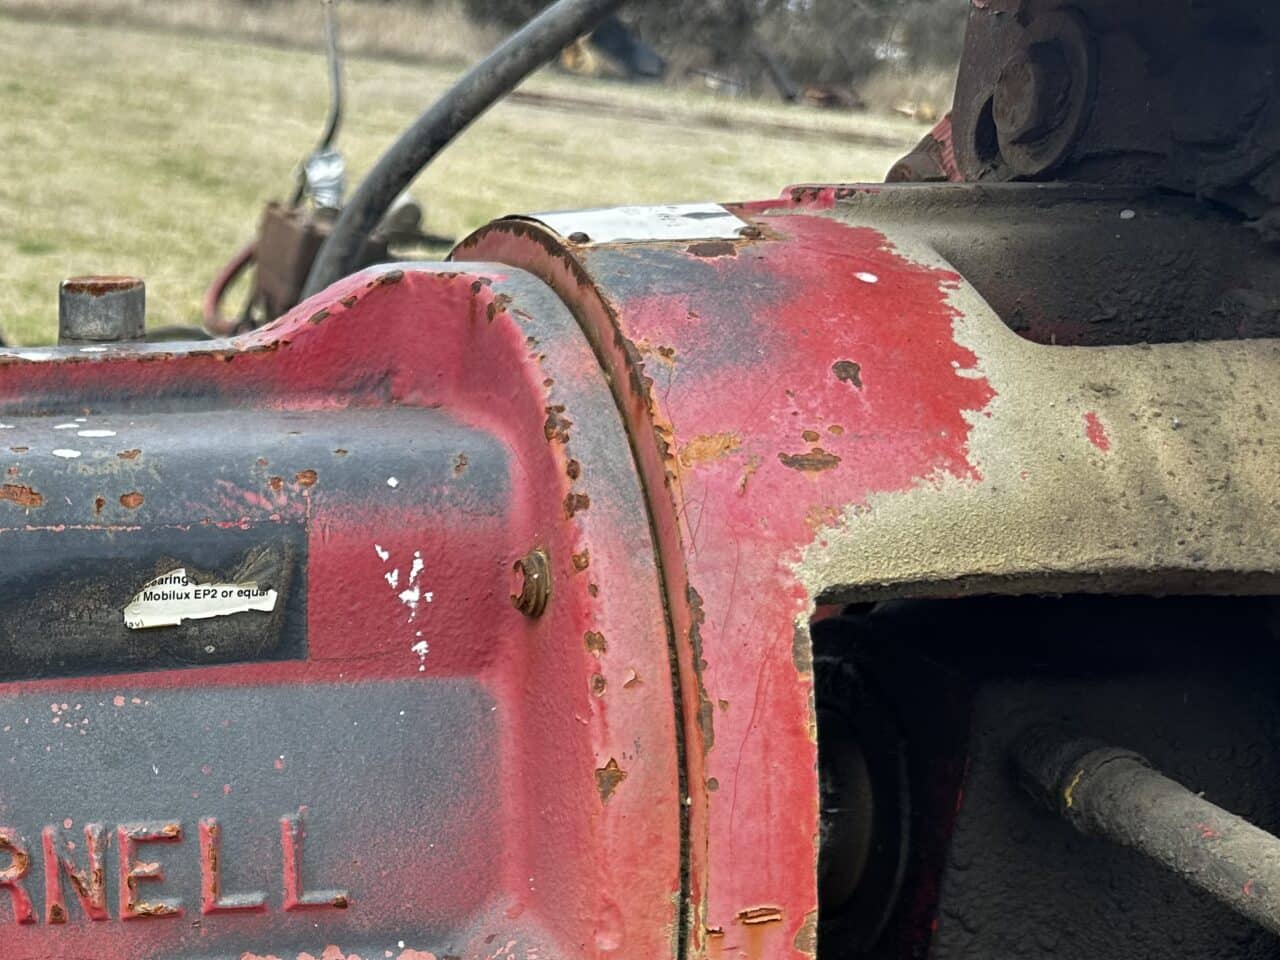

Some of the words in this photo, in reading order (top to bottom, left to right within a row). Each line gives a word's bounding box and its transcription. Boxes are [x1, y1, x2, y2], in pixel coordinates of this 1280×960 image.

[145, 575, 188, 588] earing
[143, 590, 190, 602] Mobilux
[194, 588, 218, 600] EP2
[221, 589, 234, 598] or
